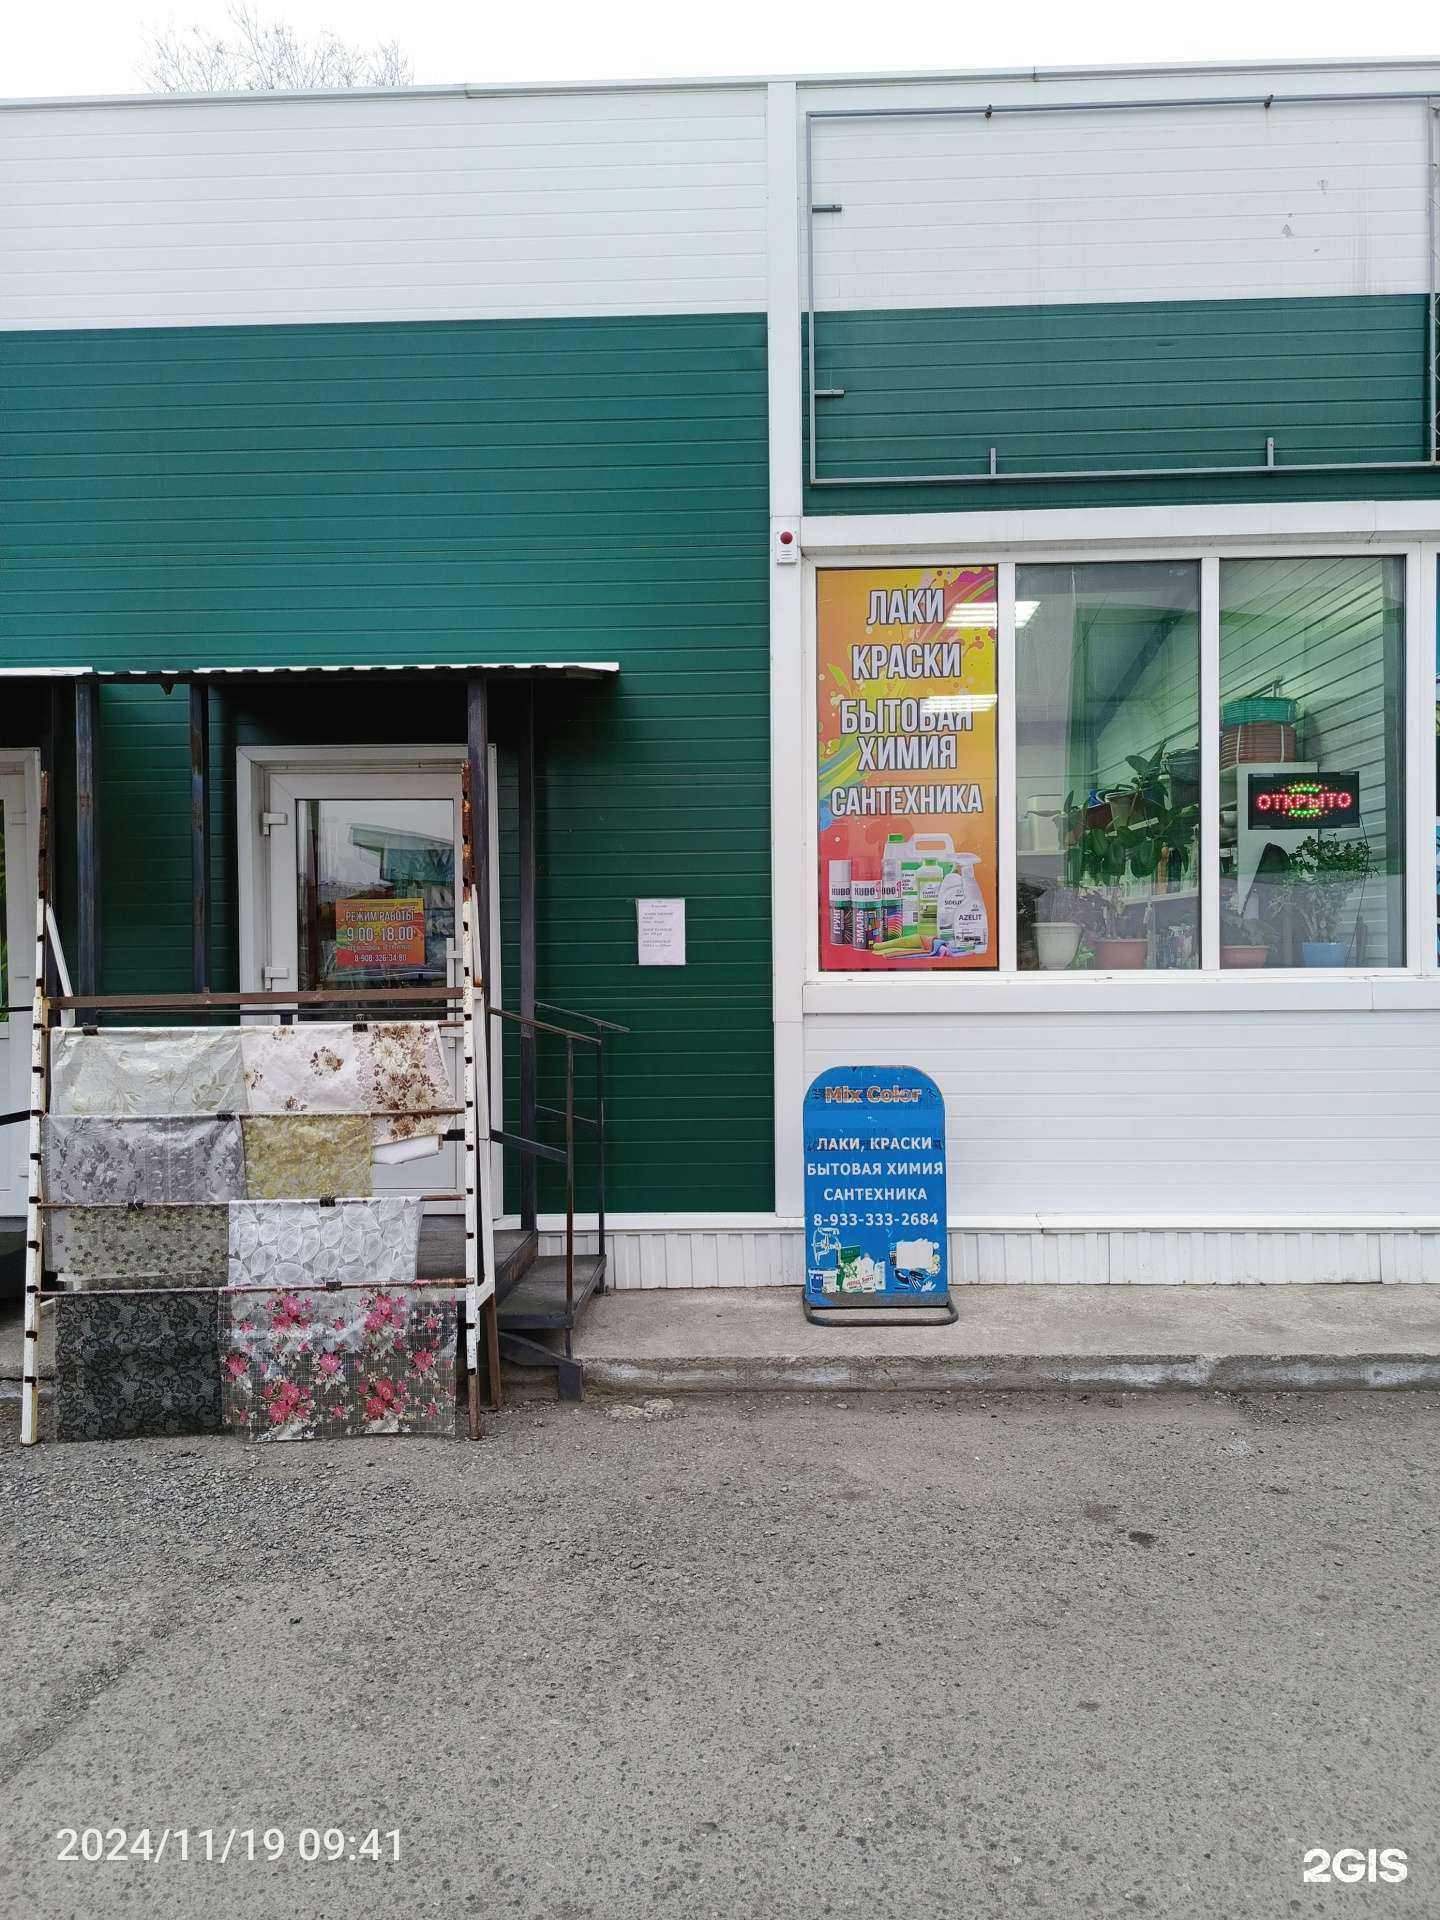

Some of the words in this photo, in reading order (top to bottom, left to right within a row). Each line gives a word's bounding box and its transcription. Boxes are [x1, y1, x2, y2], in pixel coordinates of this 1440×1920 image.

[866, 589, 945, 625] ЛАКИ
[851, 643, 962, 680] КРАСКИ
[840, 698, 973, 734] БЫТОВАЯ
[857, 735, 957, 771] ХИМИЯ
[830, 784, 983, 817] САНТЕХНИКА
[1257, 792, 1351, 810] ОТКРЫТО
[346, 911, 377, 921] РЕЖИМ
[380, 910, 414, 921] РАБОТЫ
[856, 910, 865, 944] ЭМАЛЬ
[825, 1085, 863, 1103] Mix
[866, 1085, 922, 1103] Color
[817, 1137, 865, 1152] ЛАКИ,
[871, 1136, 932, 1150] КРАСКИ
[807, 1162, 882, 1176] БЫТОВАЯ
[886, 1161, 943, 1175] ХИМИЯ
[824, 1187, 928, 1201] САНТЕХНИКА
[813, 1213, 938, 1226] 8-933-333-2684
